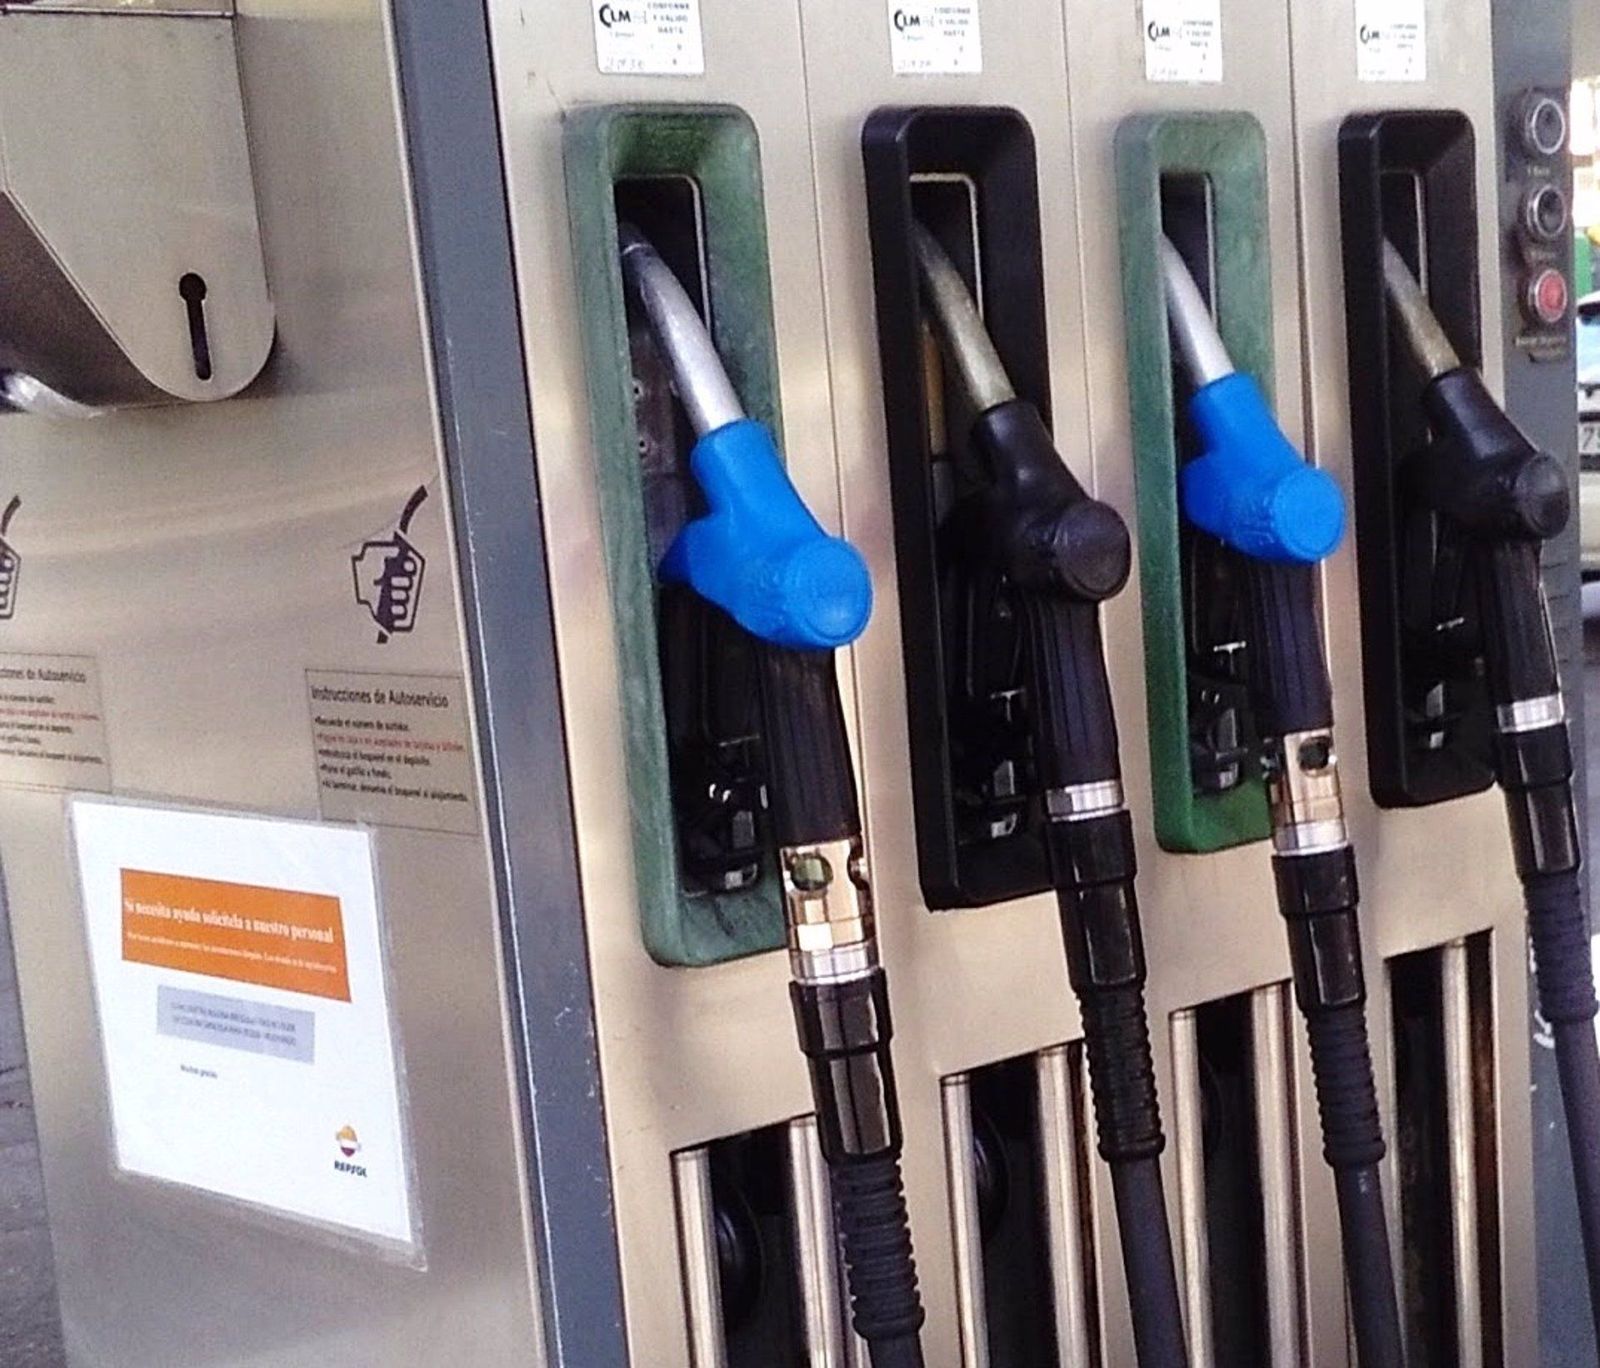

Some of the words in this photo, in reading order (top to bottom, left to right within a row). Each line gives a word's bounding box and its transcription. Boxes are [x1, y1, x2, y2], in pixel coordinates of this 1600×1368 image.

[599, 4, 631, 28] CLM
[894, 8, 920, 32] CLM
[1147, 20, 1170, 42] CLM
[311, 686, 371, 703] Instrucciones
[374, 689, 386, 704] de
[389, 690, 449, 708] Autoservicio
[173, 907, 201, 924] ayuda
[245, 919, 251, 931] a
[253, 919, 290, 937] nuestro
[290, 924, 334, 944] personal
[334, 1160, 368, 1178] REPSOL
